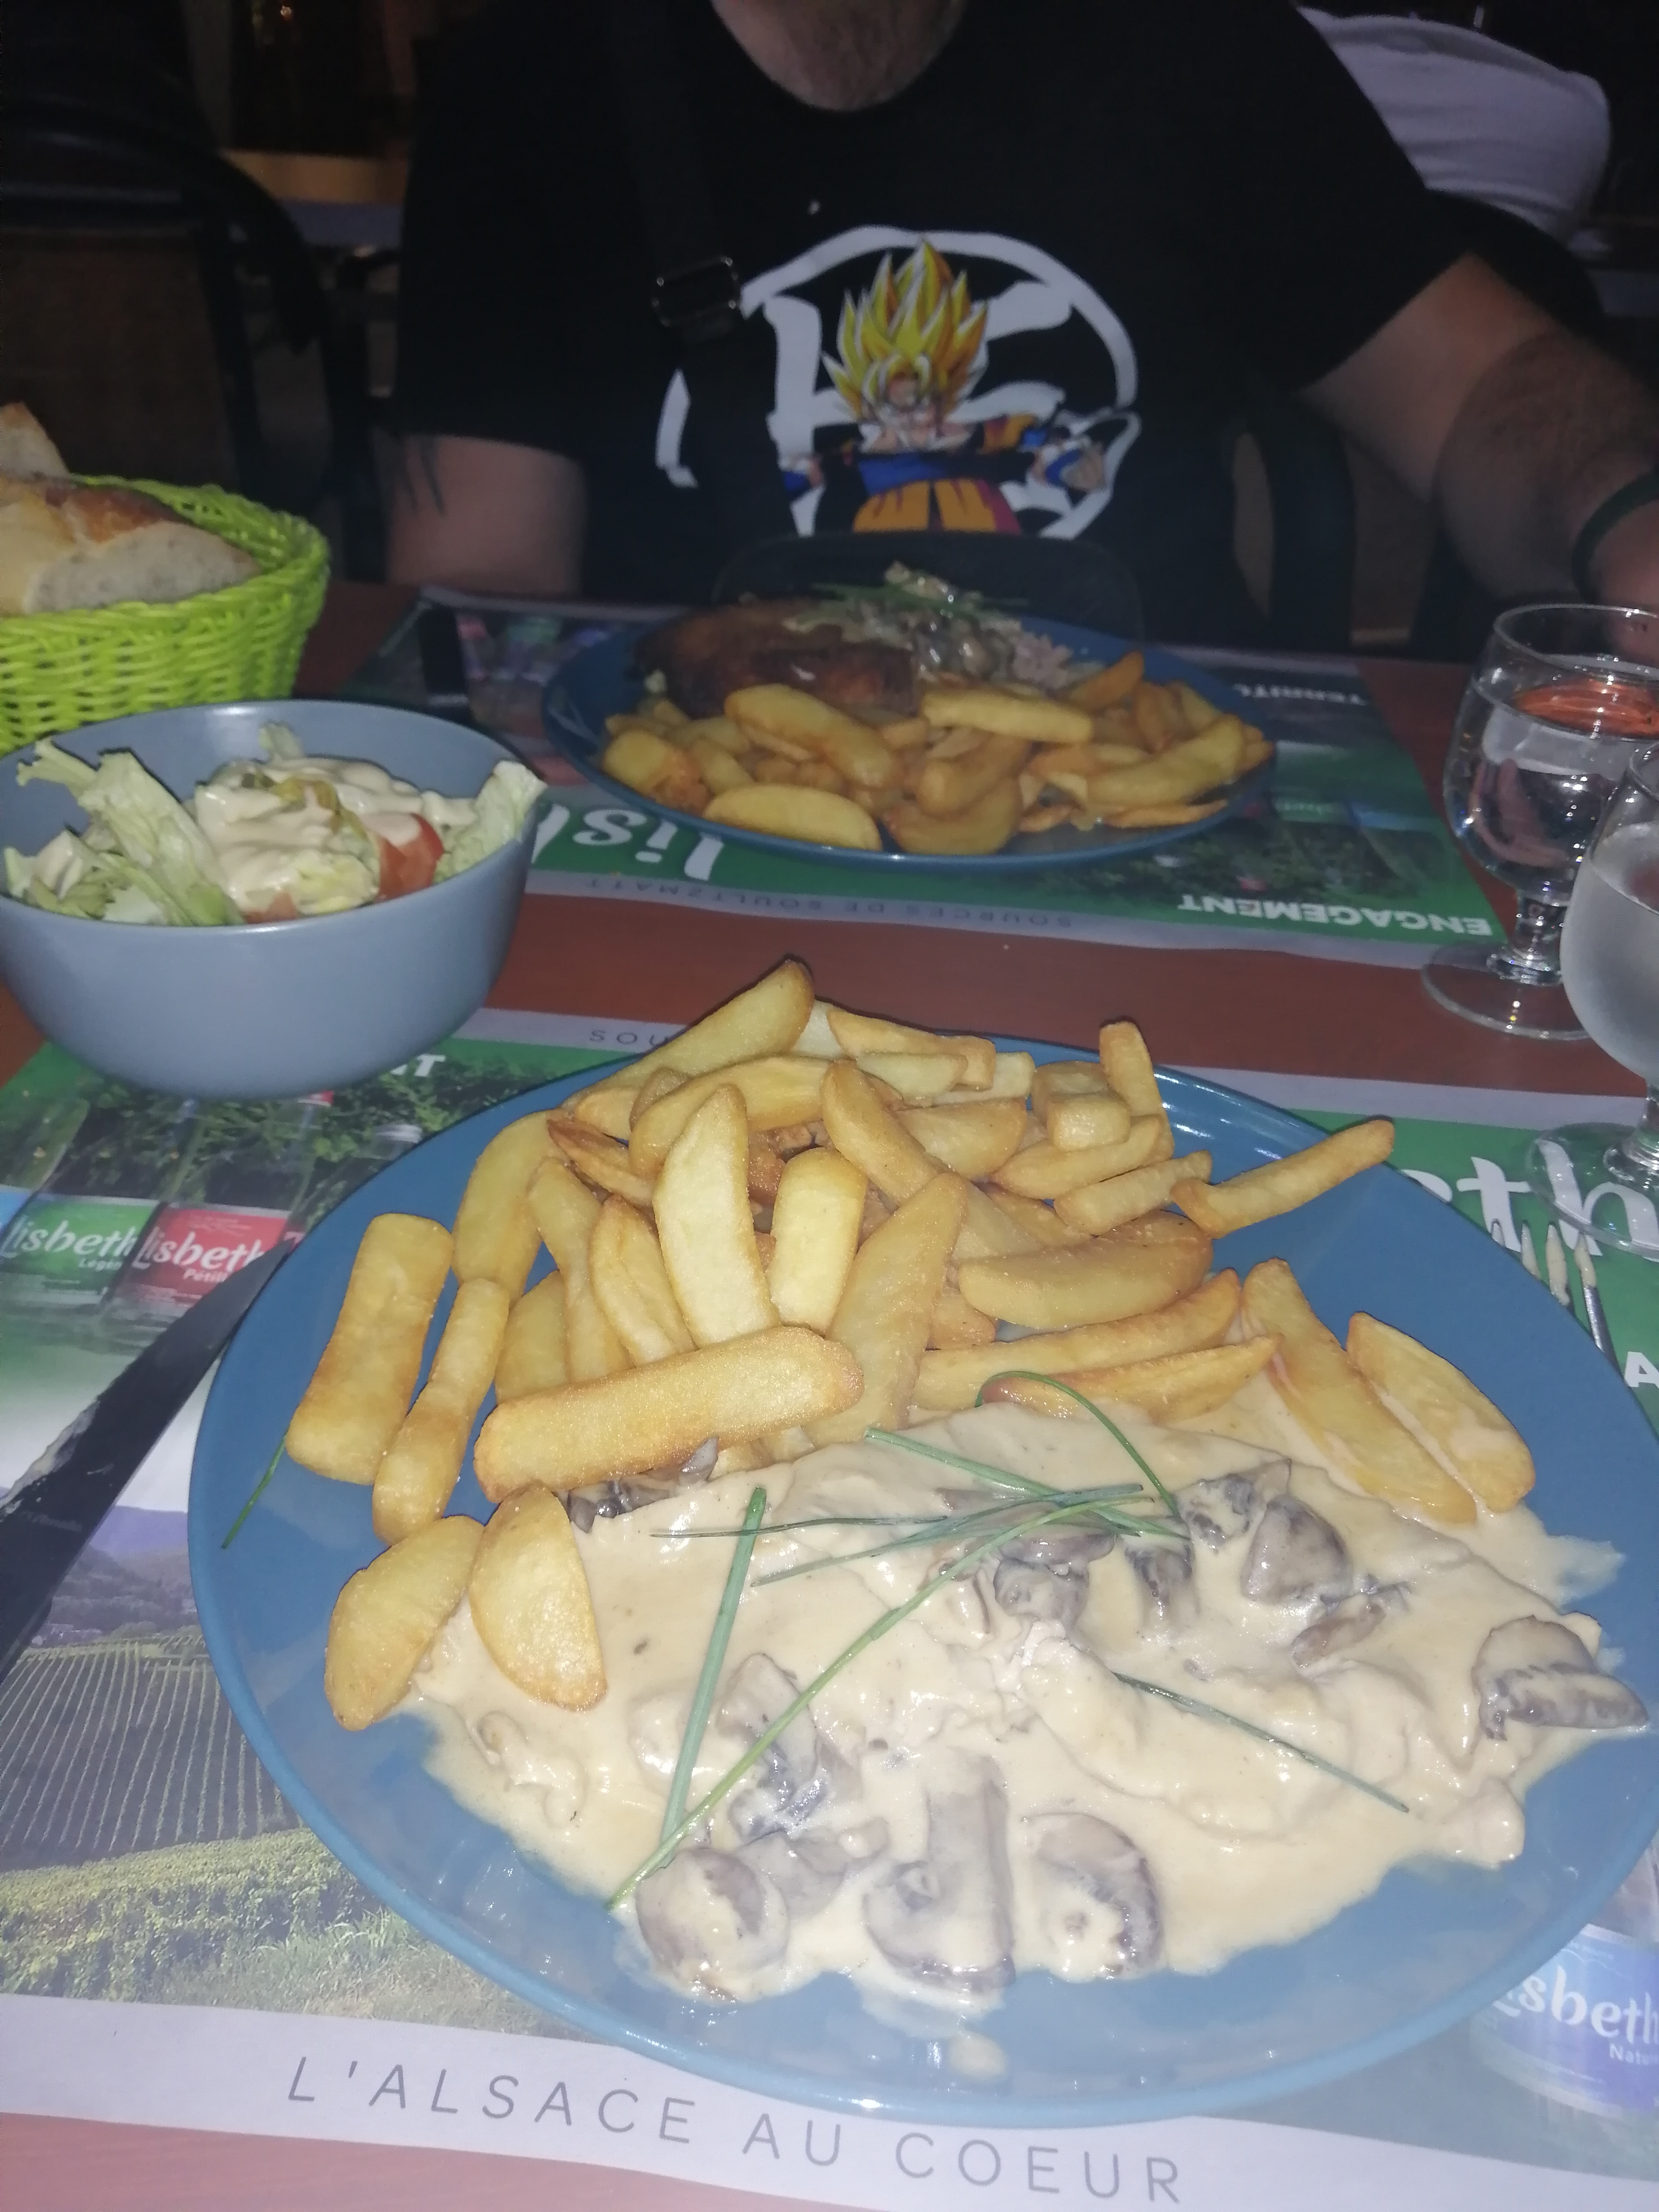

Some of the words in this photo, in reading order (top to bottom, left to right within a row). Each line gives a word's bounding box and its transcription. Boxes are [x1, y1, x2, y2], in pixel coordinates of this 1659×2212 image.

[845, 901, 884, 913] DE
[907, 906, 1071, 928] SOURCES
[1178, 893, 1493, 936] ENGAGEMENT
[1401, 1139, 1659, 1264] th
[288, 2057, 695, 2143] L'ALSACE
[743, 2113, 841, 2166] AU
[896, 2132, 1179, 2203] COEUR
